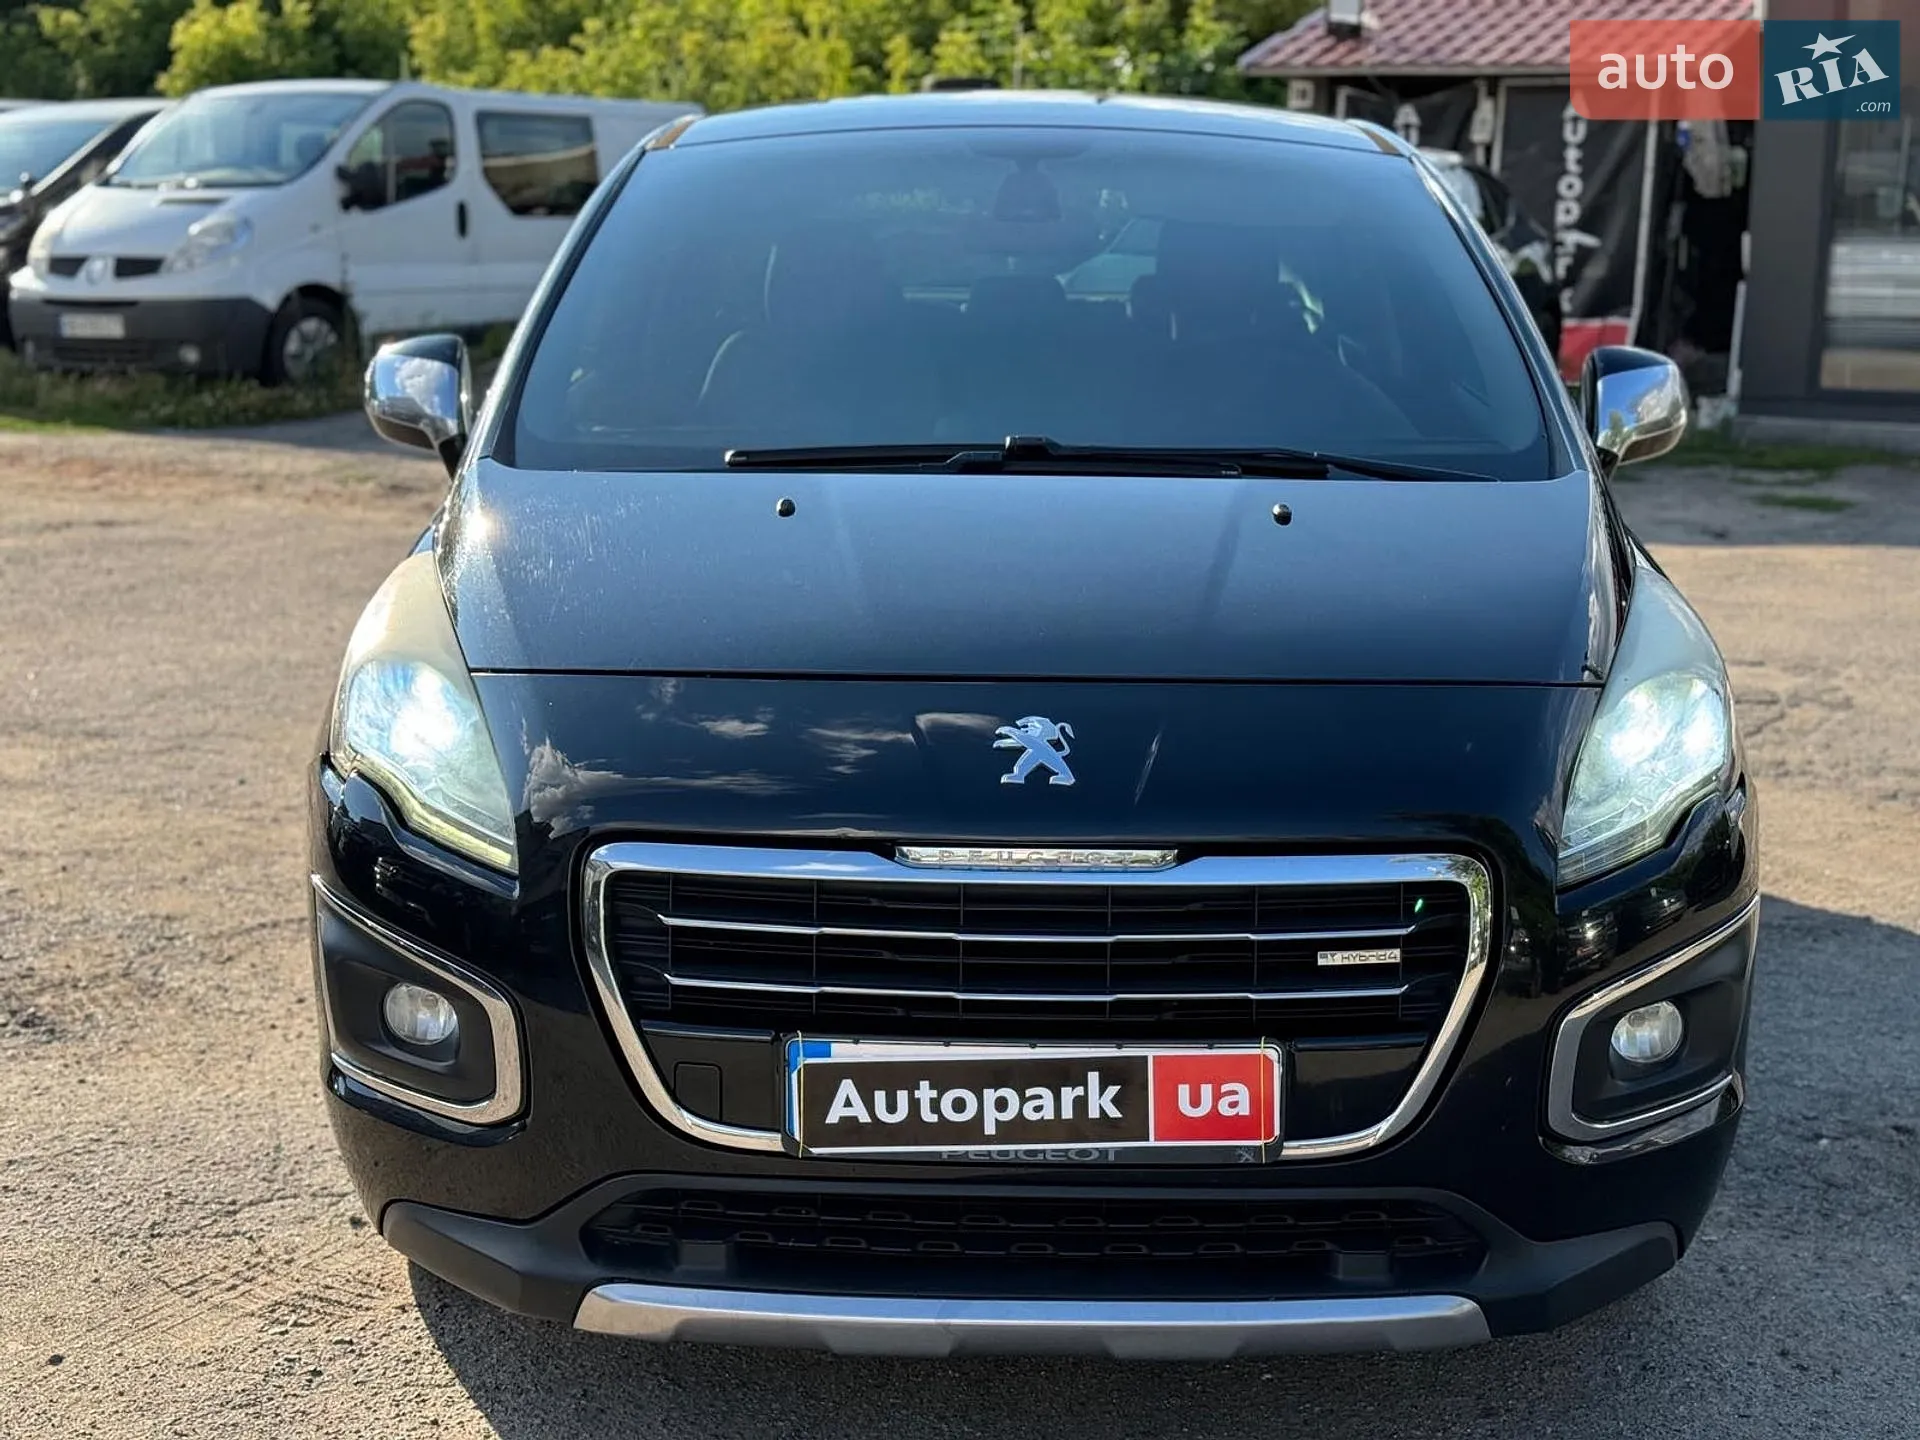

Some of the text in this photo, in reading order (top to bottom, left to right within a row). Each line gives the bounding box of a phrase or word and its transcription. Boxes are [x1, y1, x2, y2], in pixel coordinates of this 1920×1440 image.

[825, 1071, 1251, 1135] Autopark ua
[940, 1147, 1120, 1161] PEUGEOT
